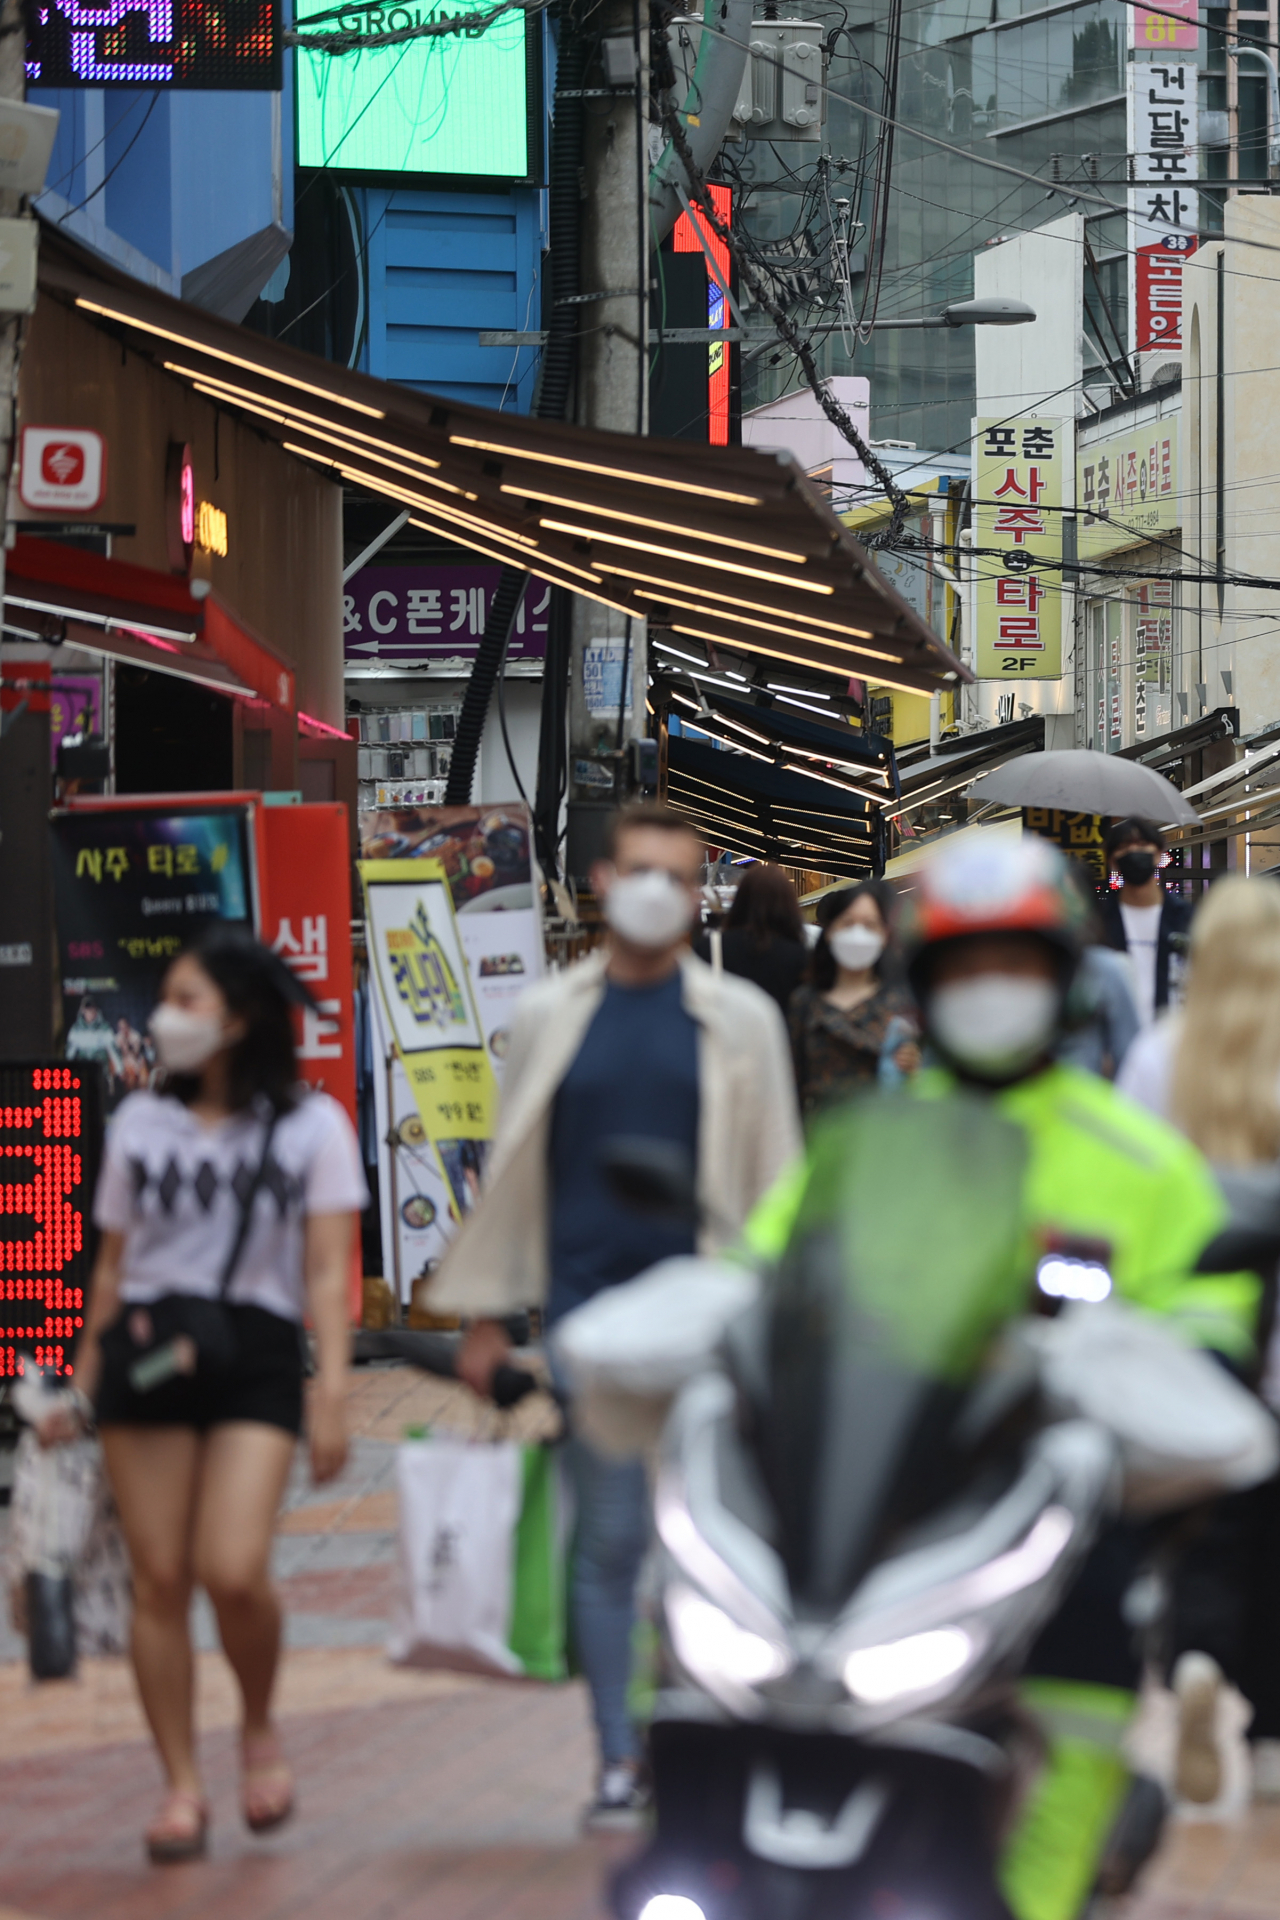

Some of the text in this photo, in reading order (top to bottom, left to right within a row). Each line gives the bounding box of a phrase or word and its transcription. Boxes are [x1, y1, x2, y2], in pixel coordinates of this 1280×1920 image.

[1148, 66, 1189, 226] 건달포차
[984, 427, 1054, 459] 포춘
[1084, 455, 1110, 527] 포춘
[1001, 657, 1037, 671] 2F
[1136, 626, 1147, 734] 포춘
[75, 843, 200, 883] 사주 타로
